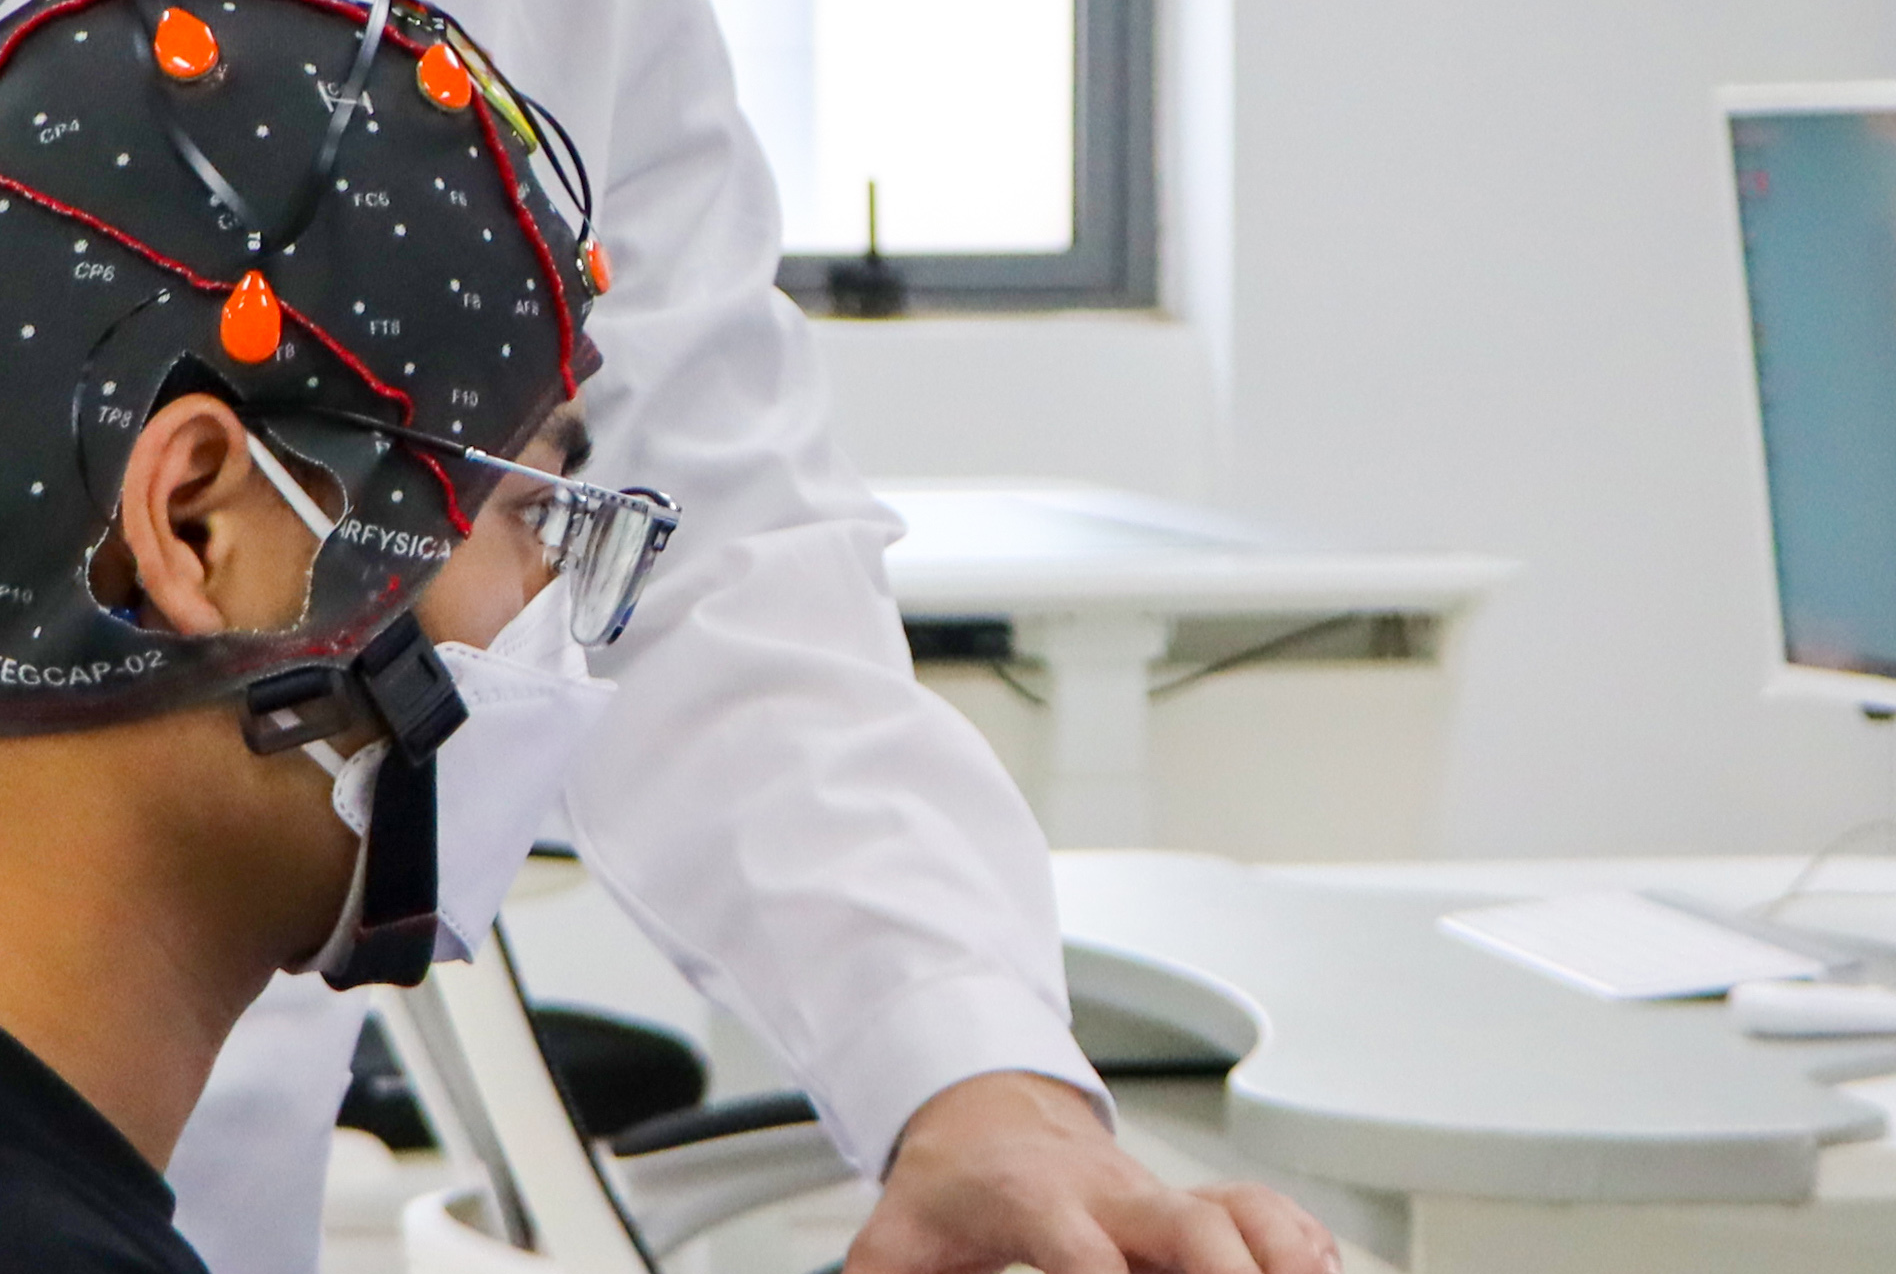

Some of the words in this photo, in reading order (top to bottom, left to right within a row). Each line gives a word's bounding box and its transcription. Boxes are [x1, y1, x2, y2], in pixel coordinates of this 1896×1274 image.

[353, 192, 391, 207] FC6
[74, 262, 115, 281] CP6
[452, 390, 479, 407] F10
[98, 407, 132, 427] TP8
[338, 519, 452, 559] ARFYSICA
